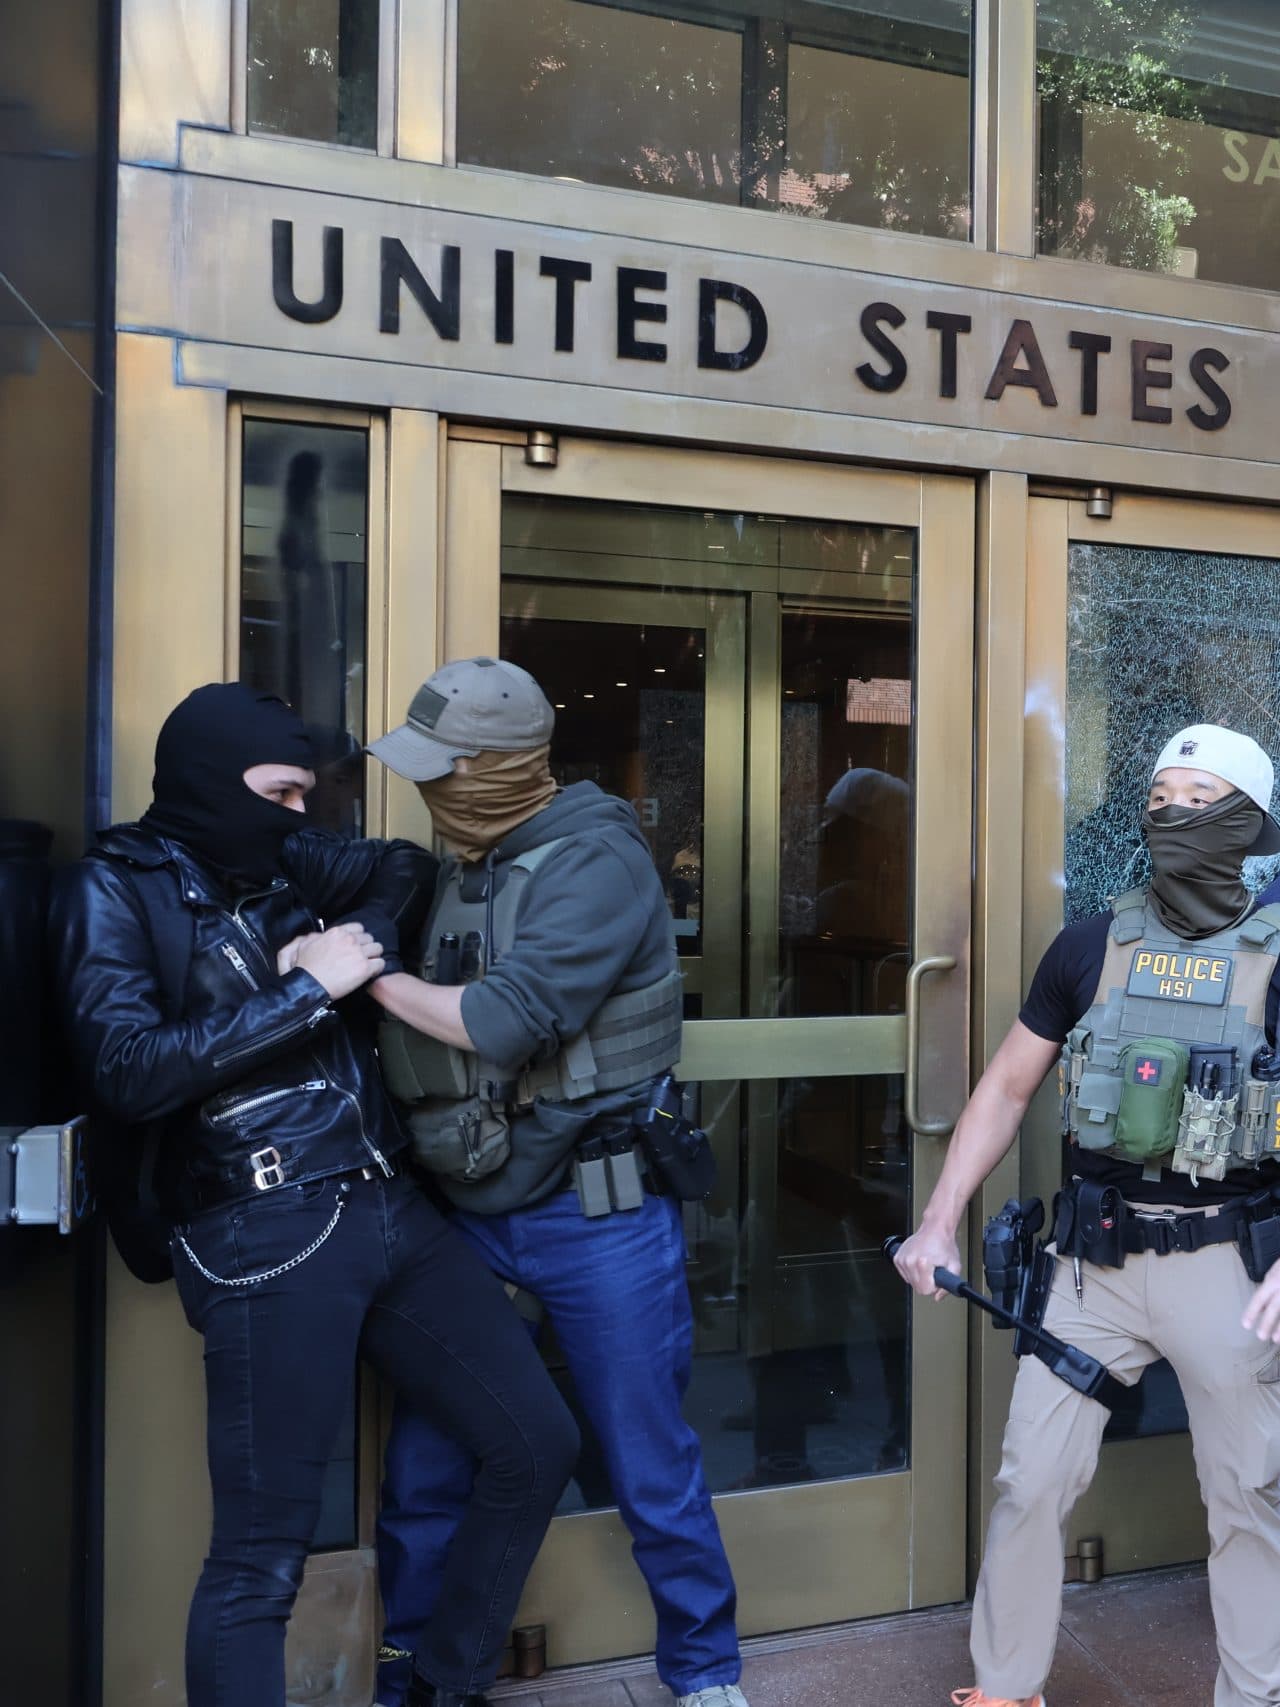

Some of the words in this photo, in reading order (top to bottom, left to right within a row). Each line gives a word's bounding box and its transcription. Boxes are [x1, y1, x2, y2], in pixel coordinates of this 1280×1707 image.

[272, 219, 769, 372] UNITED
[855, 302, 1232, 431] STATES
[1135, 952, 1226, 982] POLICE
[1159, 979, 1193, 999] HSI
